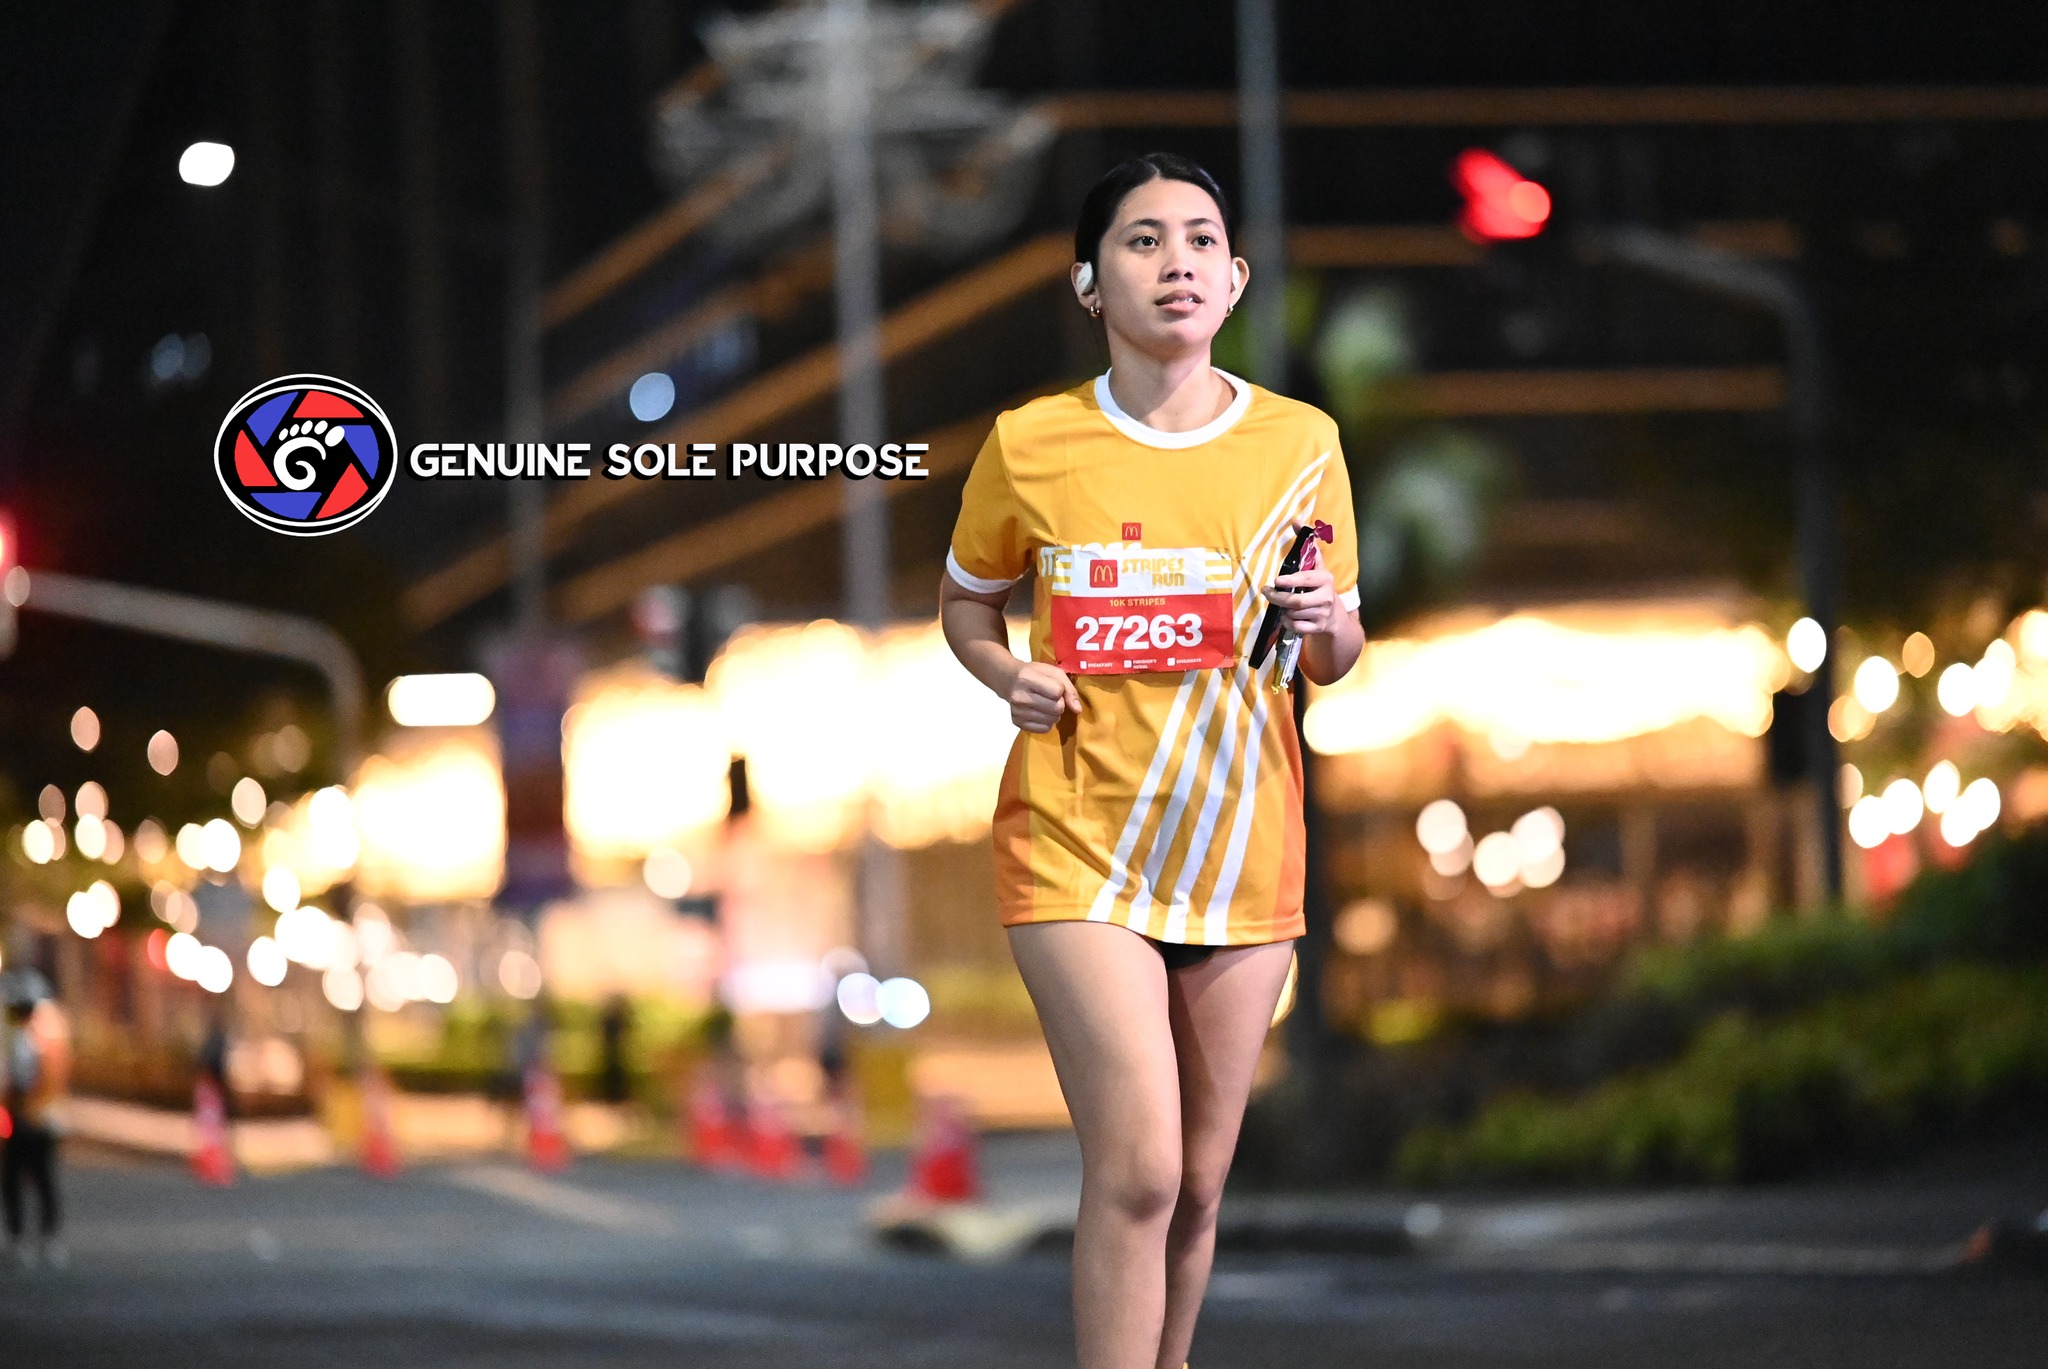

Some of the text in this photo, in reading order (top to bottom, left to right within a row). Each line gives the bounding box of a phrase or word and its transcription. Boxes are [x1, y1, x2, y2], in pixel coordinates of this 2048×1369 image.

[1121, 557, 1185, 574] STRIPES
[1151, 572, 1185, 588] RUN
[1109, 597, 1166, 607] 10K STRIPES
[1074, 613, 1203, 651] 27263
